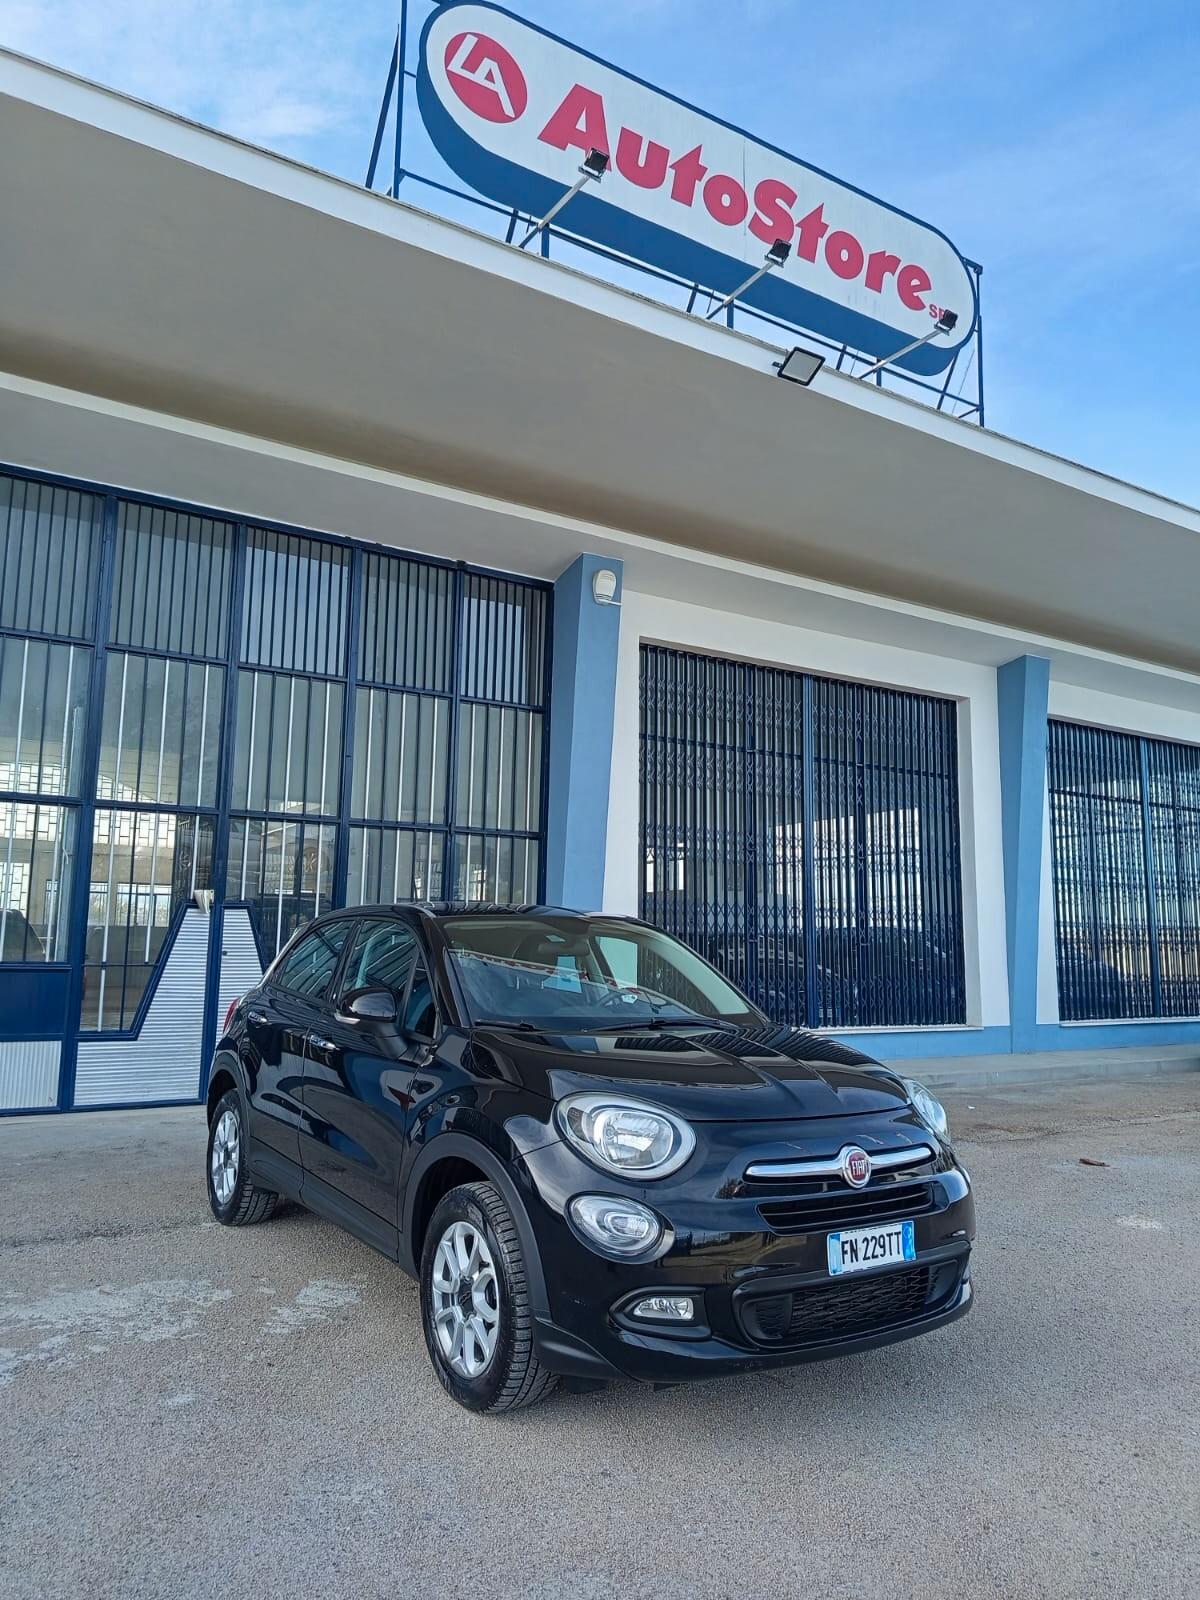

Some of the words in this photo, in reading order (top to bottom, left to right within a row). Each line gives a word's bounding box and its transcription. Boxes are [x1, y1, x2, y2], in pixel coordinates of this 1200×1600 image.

[537, 83, 932, 311] AutoStore
[851, 1159, 866, 1177] FIAT
[841, 1238, 859, 1264] FN
[862, 1231, 901, 1261] 229TT
